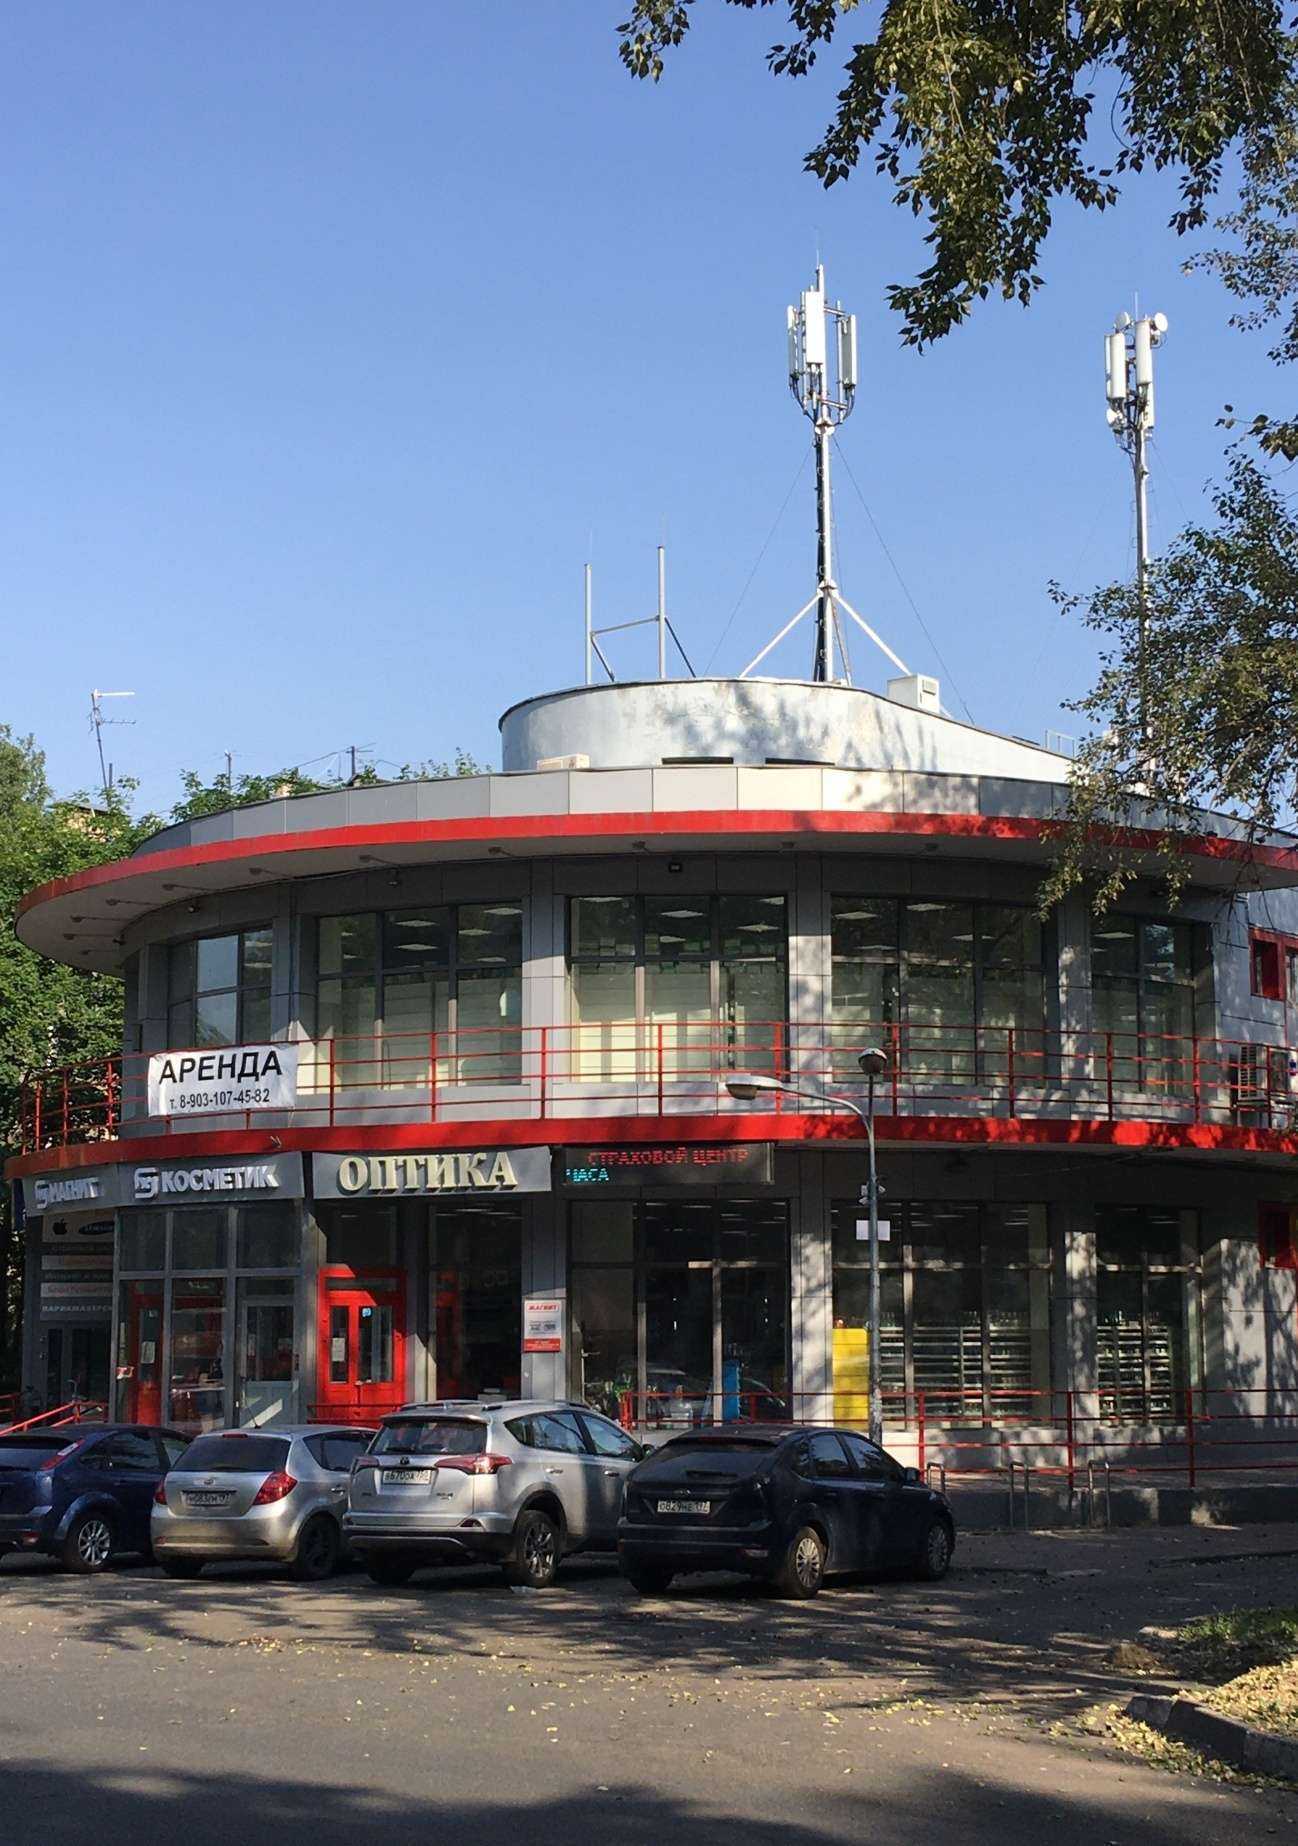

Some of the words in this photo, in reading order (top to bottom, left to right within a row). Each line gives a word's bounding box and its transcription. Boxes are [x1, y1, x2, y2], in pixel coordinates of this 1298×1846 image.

[159, 1050, 282, 1084] АРЕНДА
[179, 1088, 270, 1109] 8-903-107-45-82
[692, 1147, 749, 1167] ЦЕНТР
[160, 1165, 280, 1193] КОСМЕТИК
[338, 1151, 519, 1192] ОПТИКА
